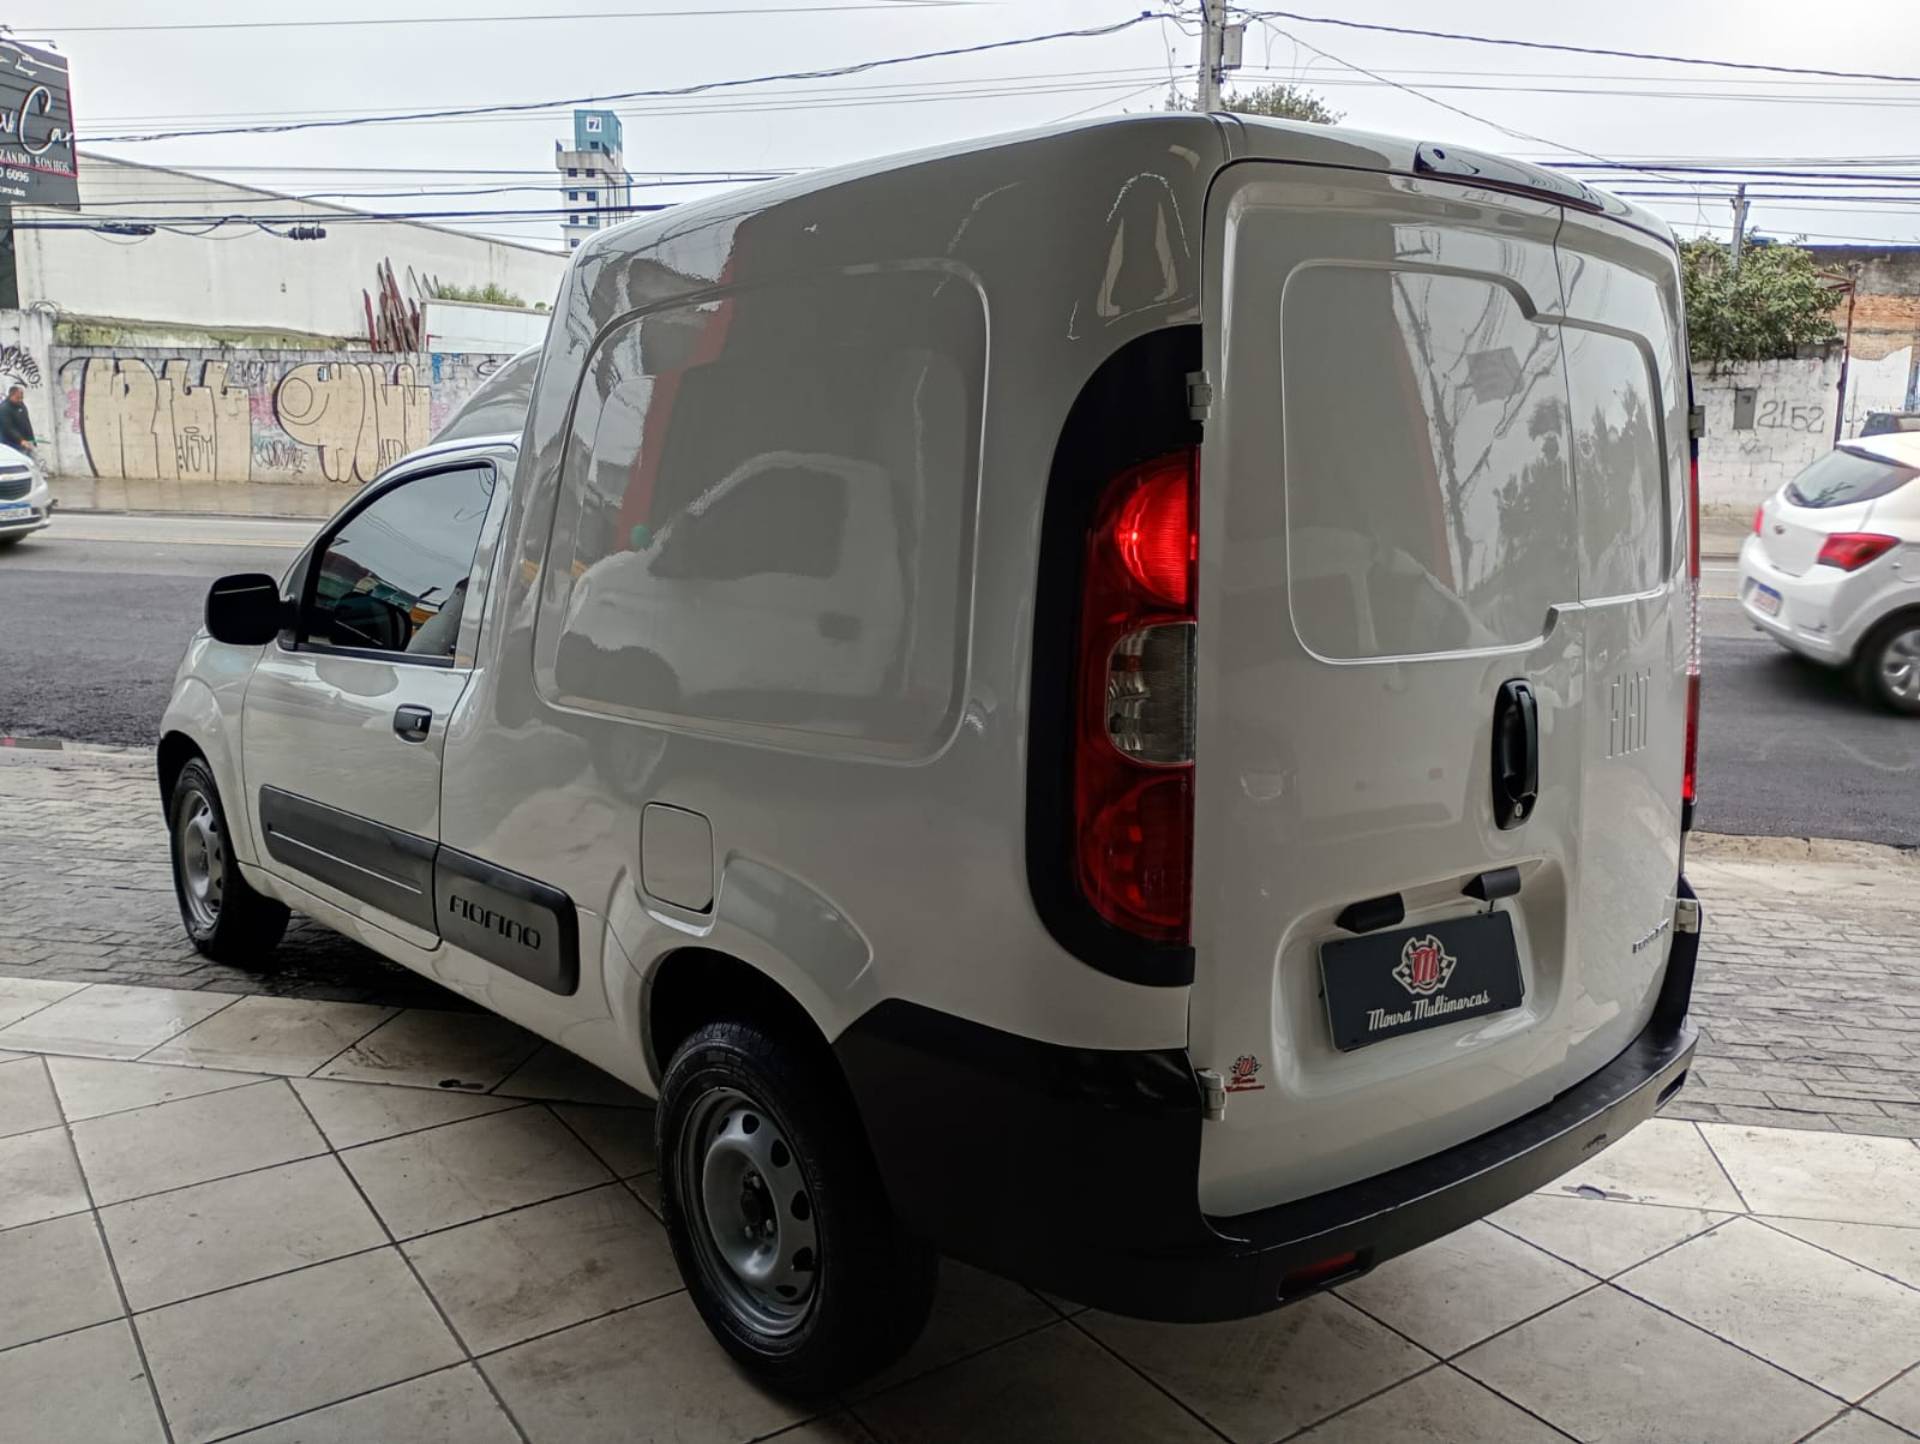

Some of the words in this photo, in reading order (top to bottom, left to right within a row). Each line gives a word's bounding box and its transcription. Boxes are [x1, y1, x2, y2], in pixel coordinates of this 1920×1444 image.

[1757, 400, 1825, 433] 2152
[1366, 1008, 1413, 1031] Moura
[1411, 989, 1491, 1020] Multimarcas
